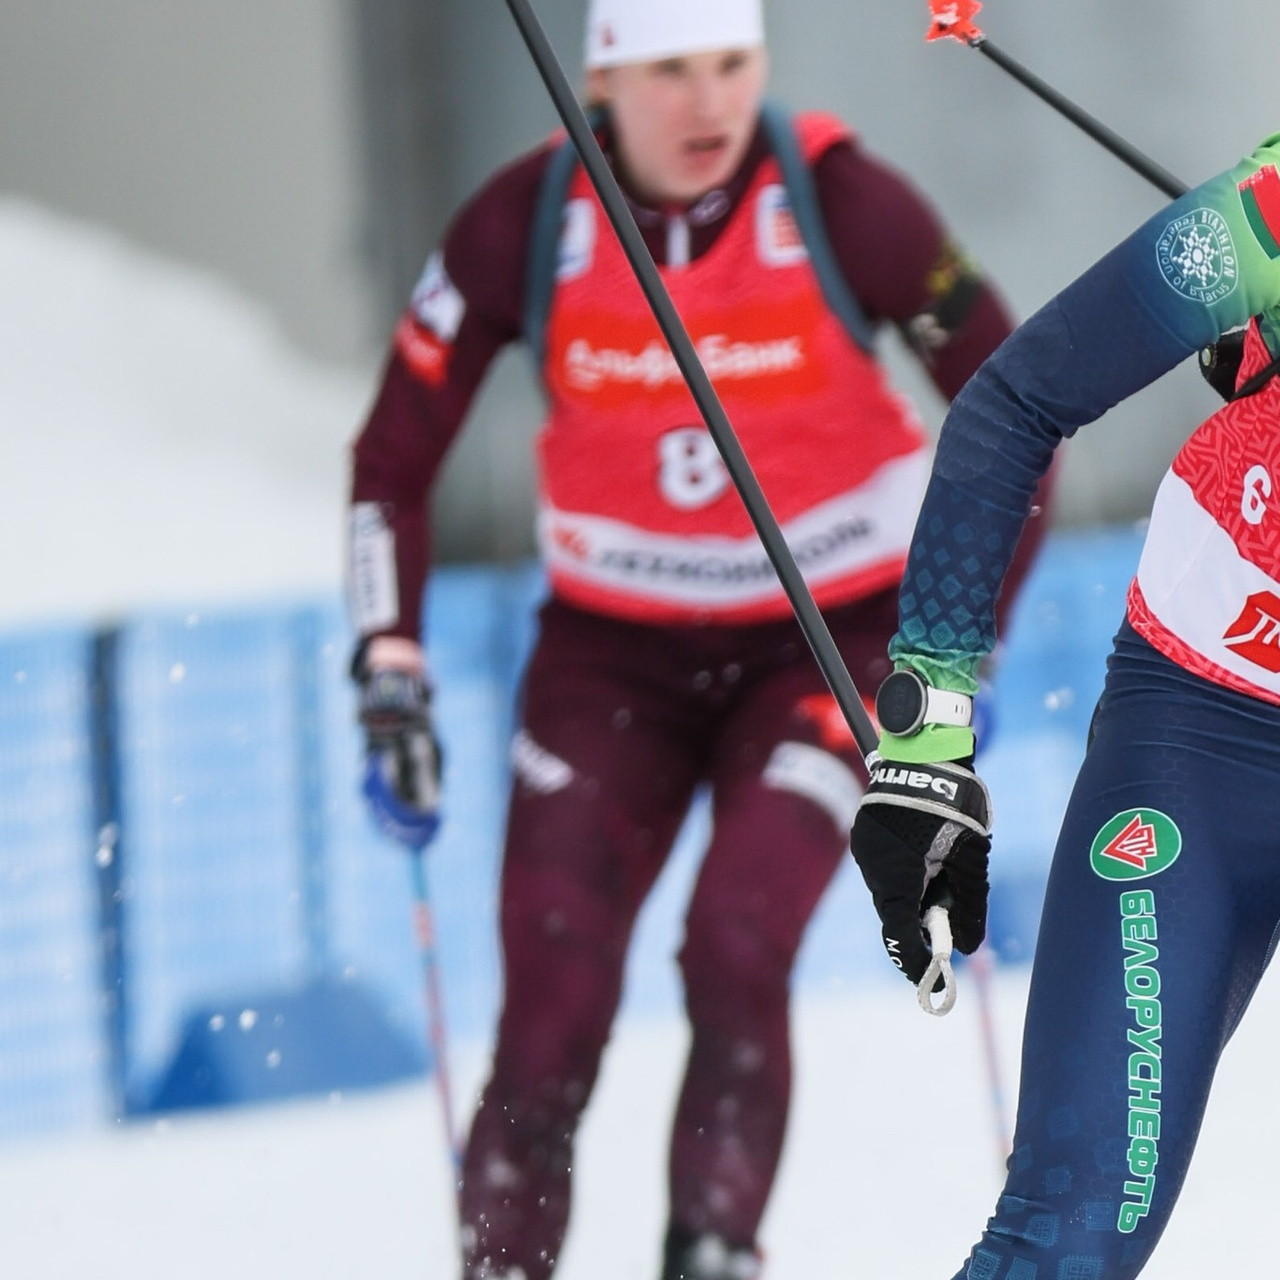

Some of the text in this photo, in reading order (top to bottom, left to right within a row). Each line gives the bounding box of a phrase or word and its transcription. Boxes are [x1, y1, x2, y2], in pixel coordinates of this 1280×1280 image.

[1201, 211, 1235, 278] BIATHLON
[656, 426, 729, 509] 8
[1241, 464, 1272, 525] 6
[1117, 888, 1163, 1234] БЕЛОРУСНЕФТЬ
